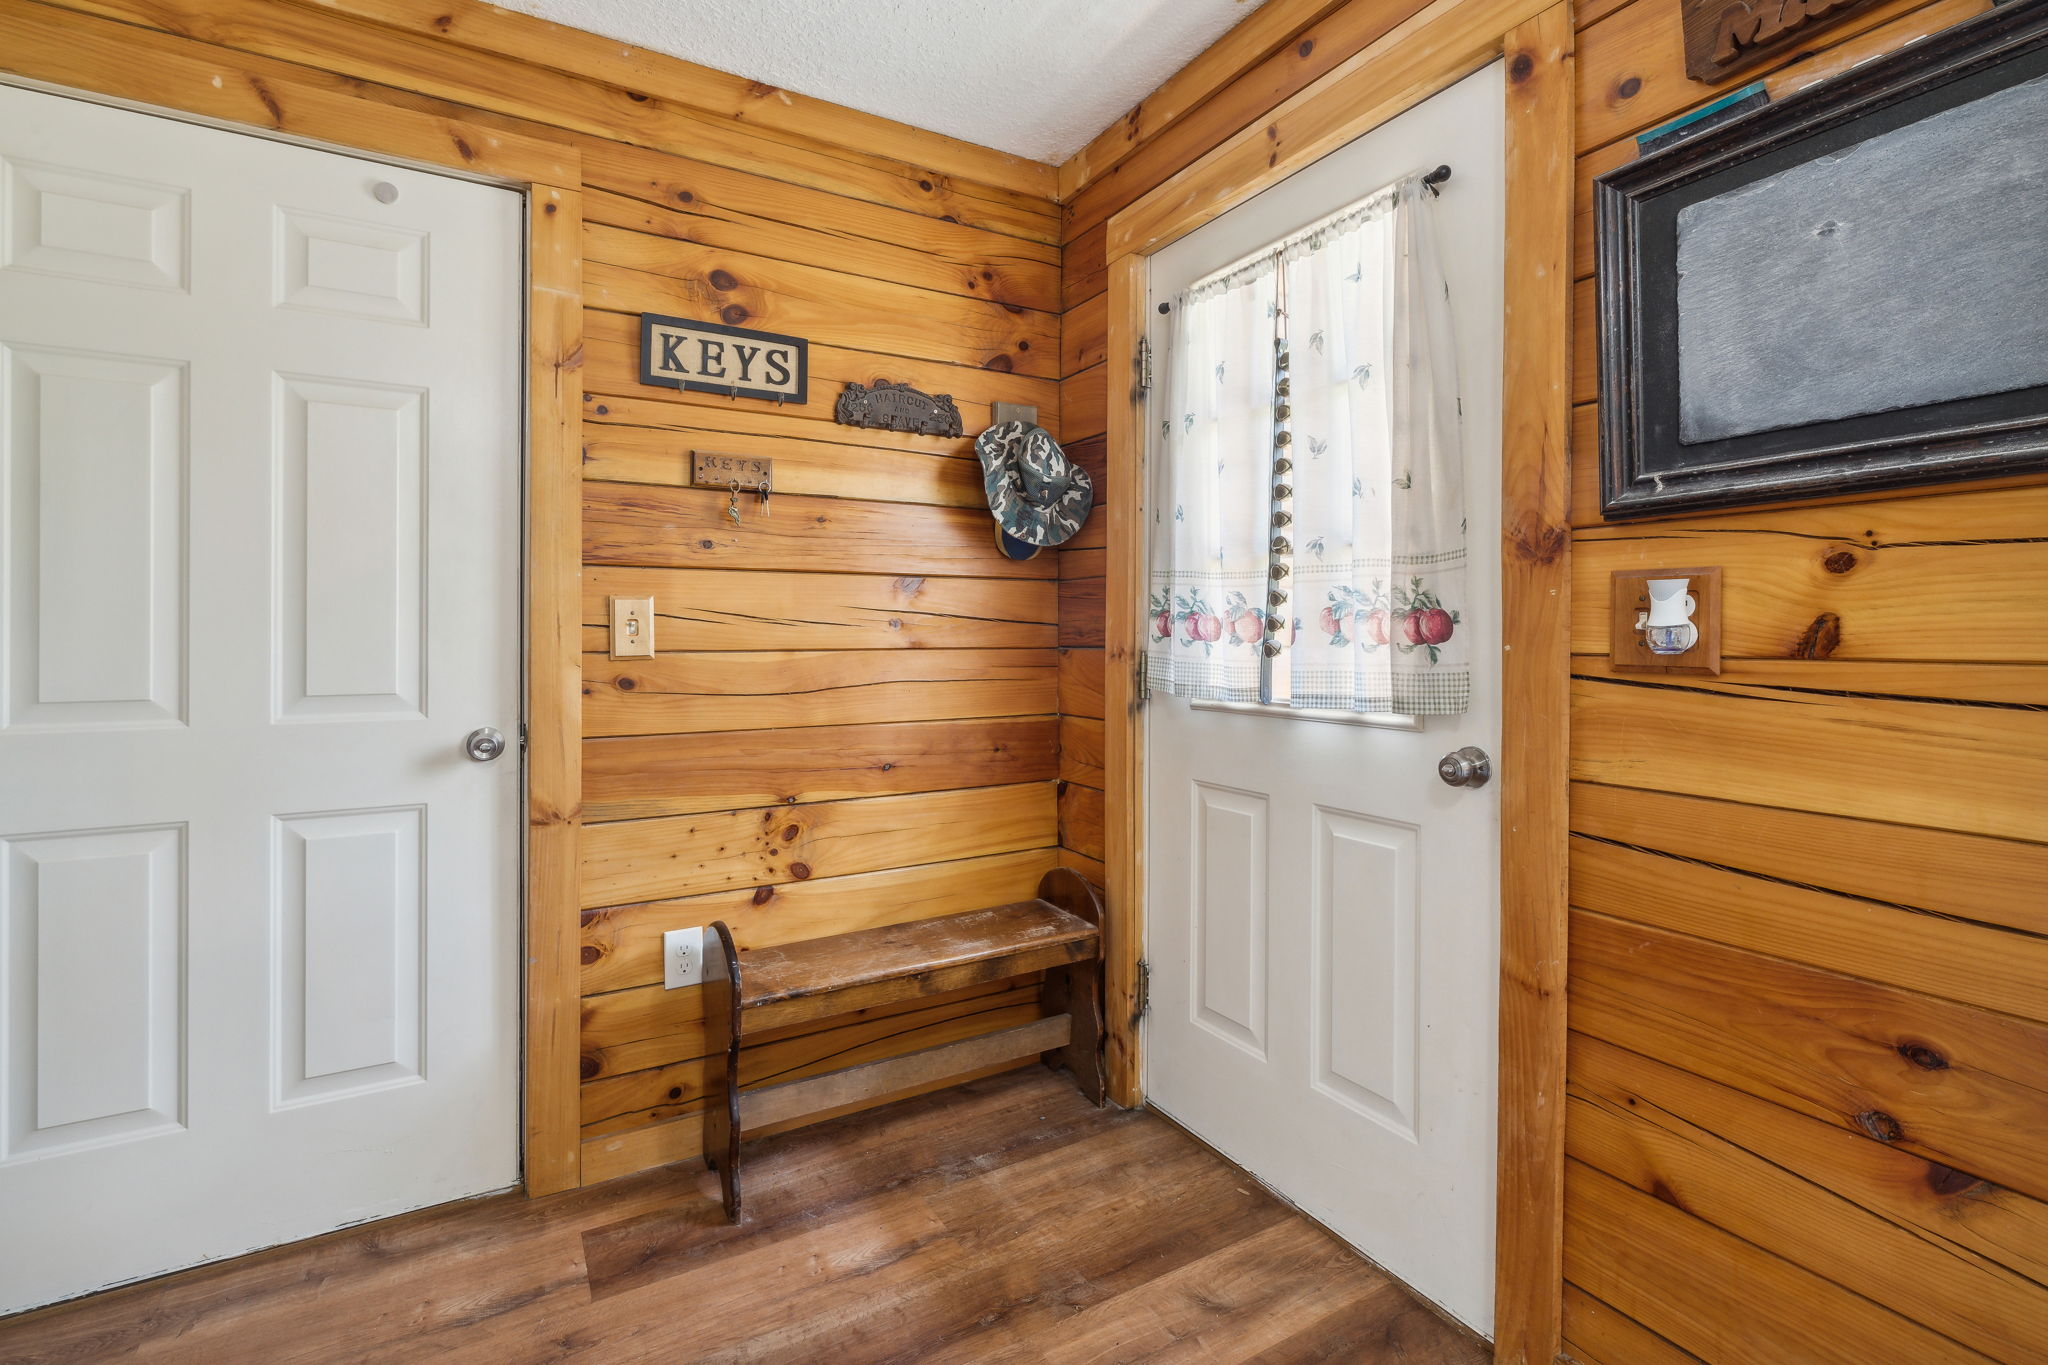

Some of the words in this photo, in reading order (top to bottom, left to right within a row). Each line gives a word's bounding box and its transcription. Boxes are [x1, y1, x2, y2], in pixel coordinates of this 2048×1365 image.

[659, 332, 791, 386] KEYS
[875, 394, 929, 410] HAIRCUT
[895, 406, 910, 415] AND
[882, 413, 919, 428] SHAVE
[703, 456, 762, 473] KEYS
